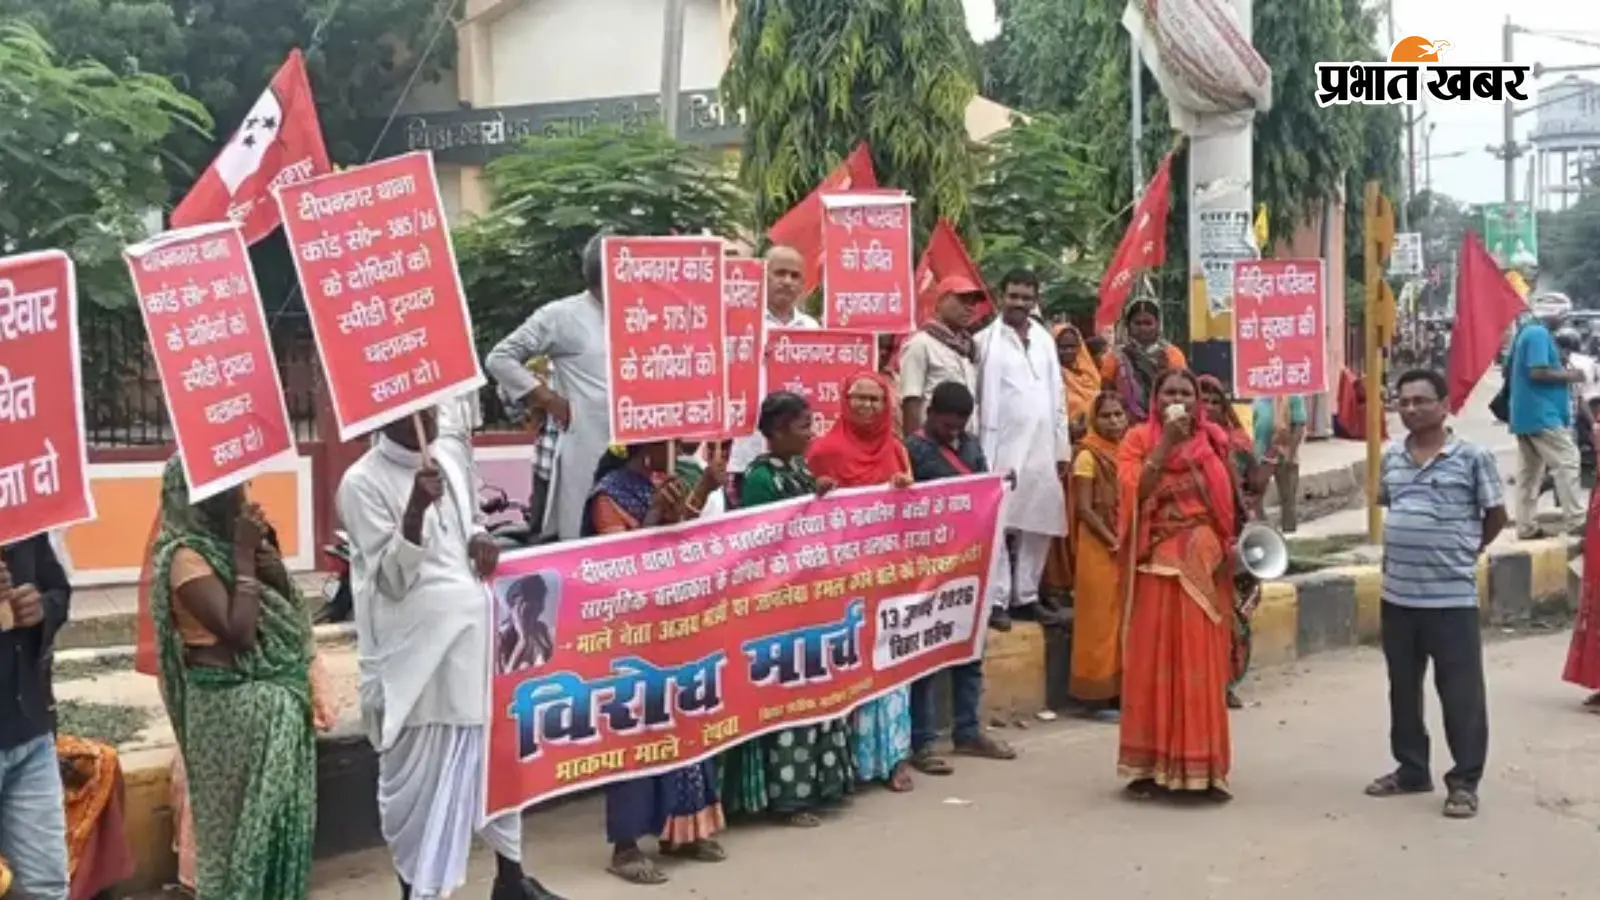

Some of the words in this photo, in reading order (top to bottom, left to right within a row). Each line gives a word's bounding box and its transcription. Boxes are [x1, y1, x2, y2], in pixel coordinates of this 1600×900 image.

[297, 186, 373, 220] दीपनगर
[376, 174, 416, 202] थाना
[301, 230, 343, 261] कांड
[840, 242, 860, 272] को
[861, 238, 893, 272] उचित
[320, 269, 342, 297] के
[407, 243, 431, 271] को
[612, 245, 682, 282] दीपनगर
[682, 247, 715, 283] कांड
[1276, 264, 1316, 296] परिवार
[336, 295, 388, 335] स्पीडी
[835, 290, 886, 327] मुआवजा
[888, 282, 903, 315] दो
[165, 320, 185, 352] के
[228, 306, 248, 336] को
[364, 327, 429, 363] चलाकर
[1239, 310, 1259, 341] को
[1259, 315, 1295, 350] सुरक्षा
[1297, 305, 1315, 337] की
[619, 346, 638, 381] के
[642, 343, 694, 380] दोषियों
[695, 342, 717, 376] को
[774, 335, 835, 366] दीपनगर
[839, 337, 868, 366] कांड
[371, 372, 411, 403] सजा
[1284, 356, 1312, 386] करो
[617, 395, 685, 432] गिरफ्तार
[30, 438, 60, 496] दो
[708, 532, 726, 556] के
[576, 626, 613, 653] माले
[619, 621, 652, 646] नेता
[880, 608, 899, 630] 13
[889, 631, 920, 660] बिहार
[508, 650, 727, 762] विरोध
[743, 597, 865, 688] मार्च
[633, 736, 680, 764] माले
